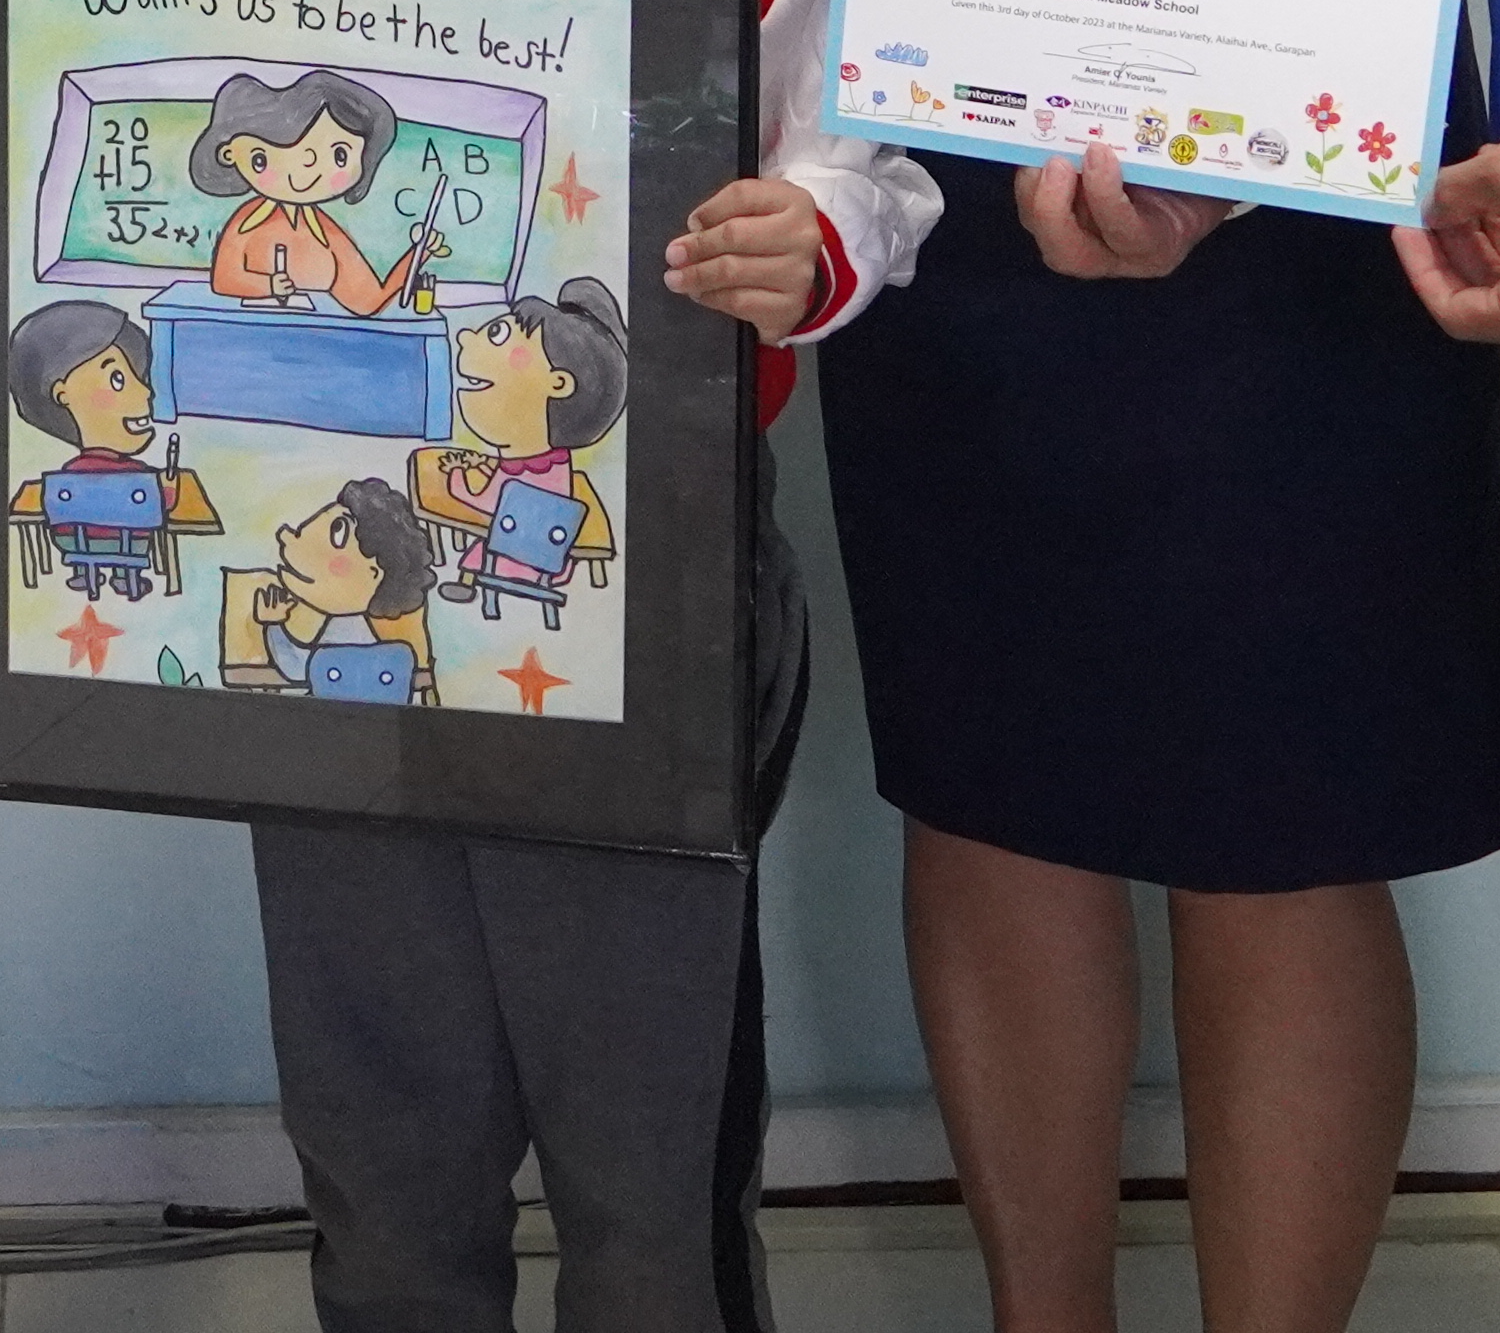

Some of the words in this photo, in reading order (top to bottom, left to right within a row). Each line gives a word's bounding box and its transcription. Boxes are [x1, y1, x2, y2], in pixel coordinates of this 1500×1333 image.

[386, 3, 460, 55] the
[478, 17, 574, 73] best!
[978, 1, 996, 13] this
[997, 4, 1012, 16] 3rd
[1013, 6, 1030, 20] day
[1031, 9, 1042, 20] of
[1043, 11, 1081, 25] October
[1083, 16, 1105, 29] 2023
[1107, 20, 1117, 30] at
[1118, 20, 1134, 32] the
[1135, 24, 1178, 39] Marianas
[1179, 29, 1214, 45] Variety,
[1274, 42, 1317, 58] Garapan
[1126, 71, 1156, 83] Younis
[957, 88, 1027, 106] enterprise
[1073, 99, 1128, 116] KINPACHI
[103, 117, 149, 145] 20
[976, 113, 1017, 128] SAIPAN
[422, 137, 443, 172] A
[464, 143, 490, 175] B
[394, 187, 417, 217] C
[453, 188, 484, 226] D
[106, 206, 151, 245] 35
